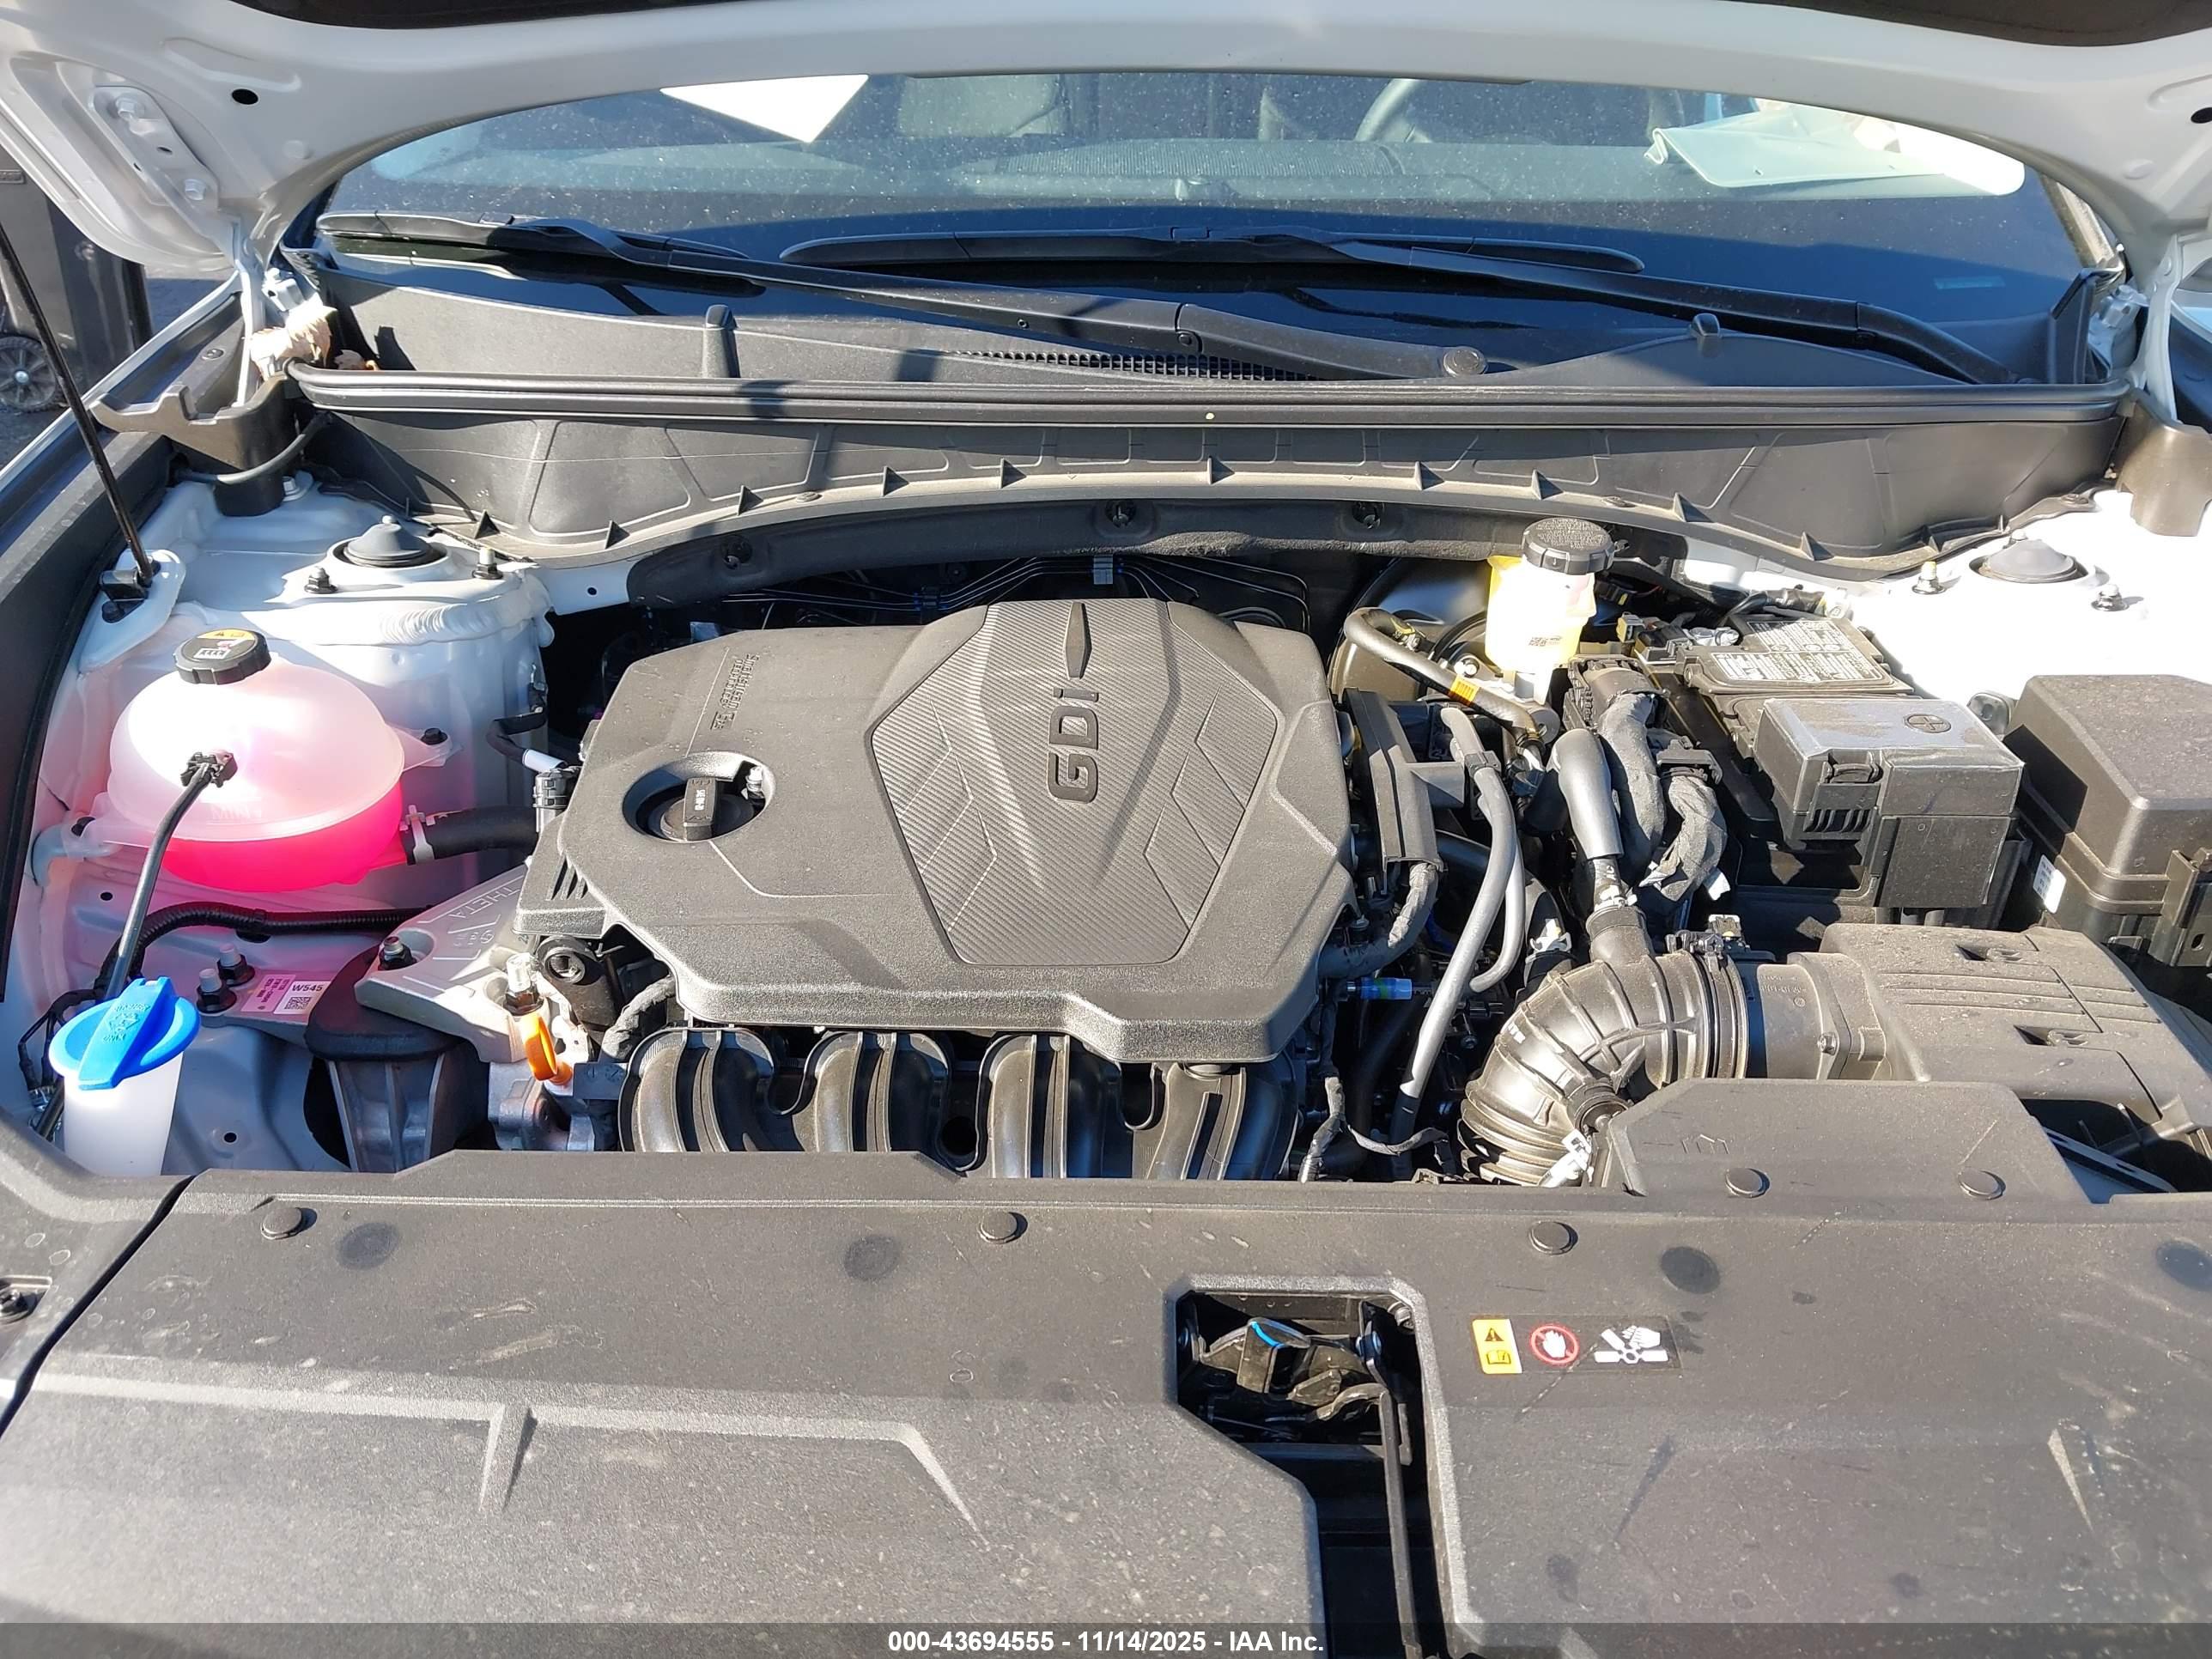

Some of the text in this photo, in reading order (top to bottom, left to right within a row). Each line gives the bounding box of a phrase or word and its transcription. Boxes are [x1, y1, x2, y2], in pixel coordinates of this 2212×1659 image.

[1047, 686, 1099, 805] GDi
[447, 886, 521, 920] THETA
[292, 983, 325, 992] W545
